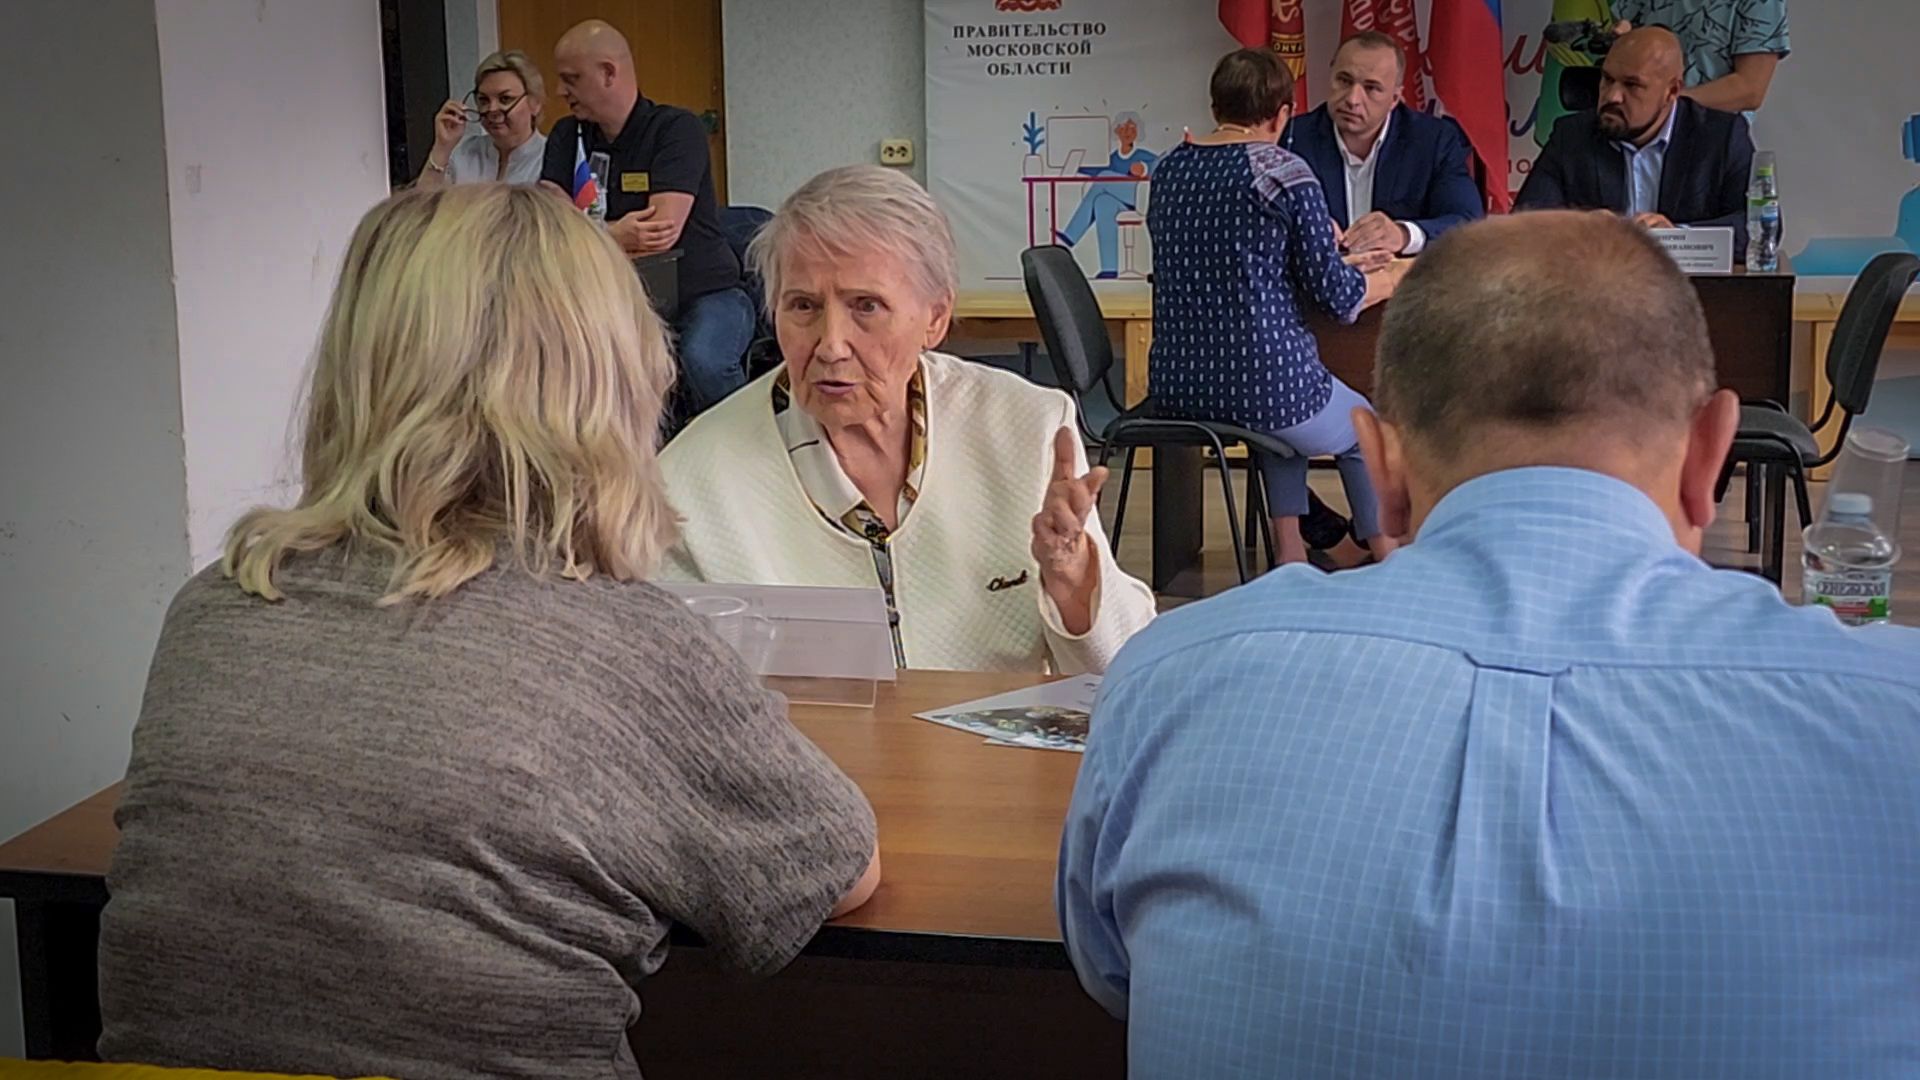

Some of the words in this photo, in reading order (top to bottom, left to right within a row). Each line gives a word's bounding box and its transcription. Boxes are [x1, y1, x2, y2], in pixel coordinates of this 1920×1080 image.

[953, 22, 1107, 38] ПРАВИТЕЛЬСТВО
[967, 39, 1091, 57] МОСКОВСКОЙ
[987, 61, 1071, 76] ОБЛАСТИ
